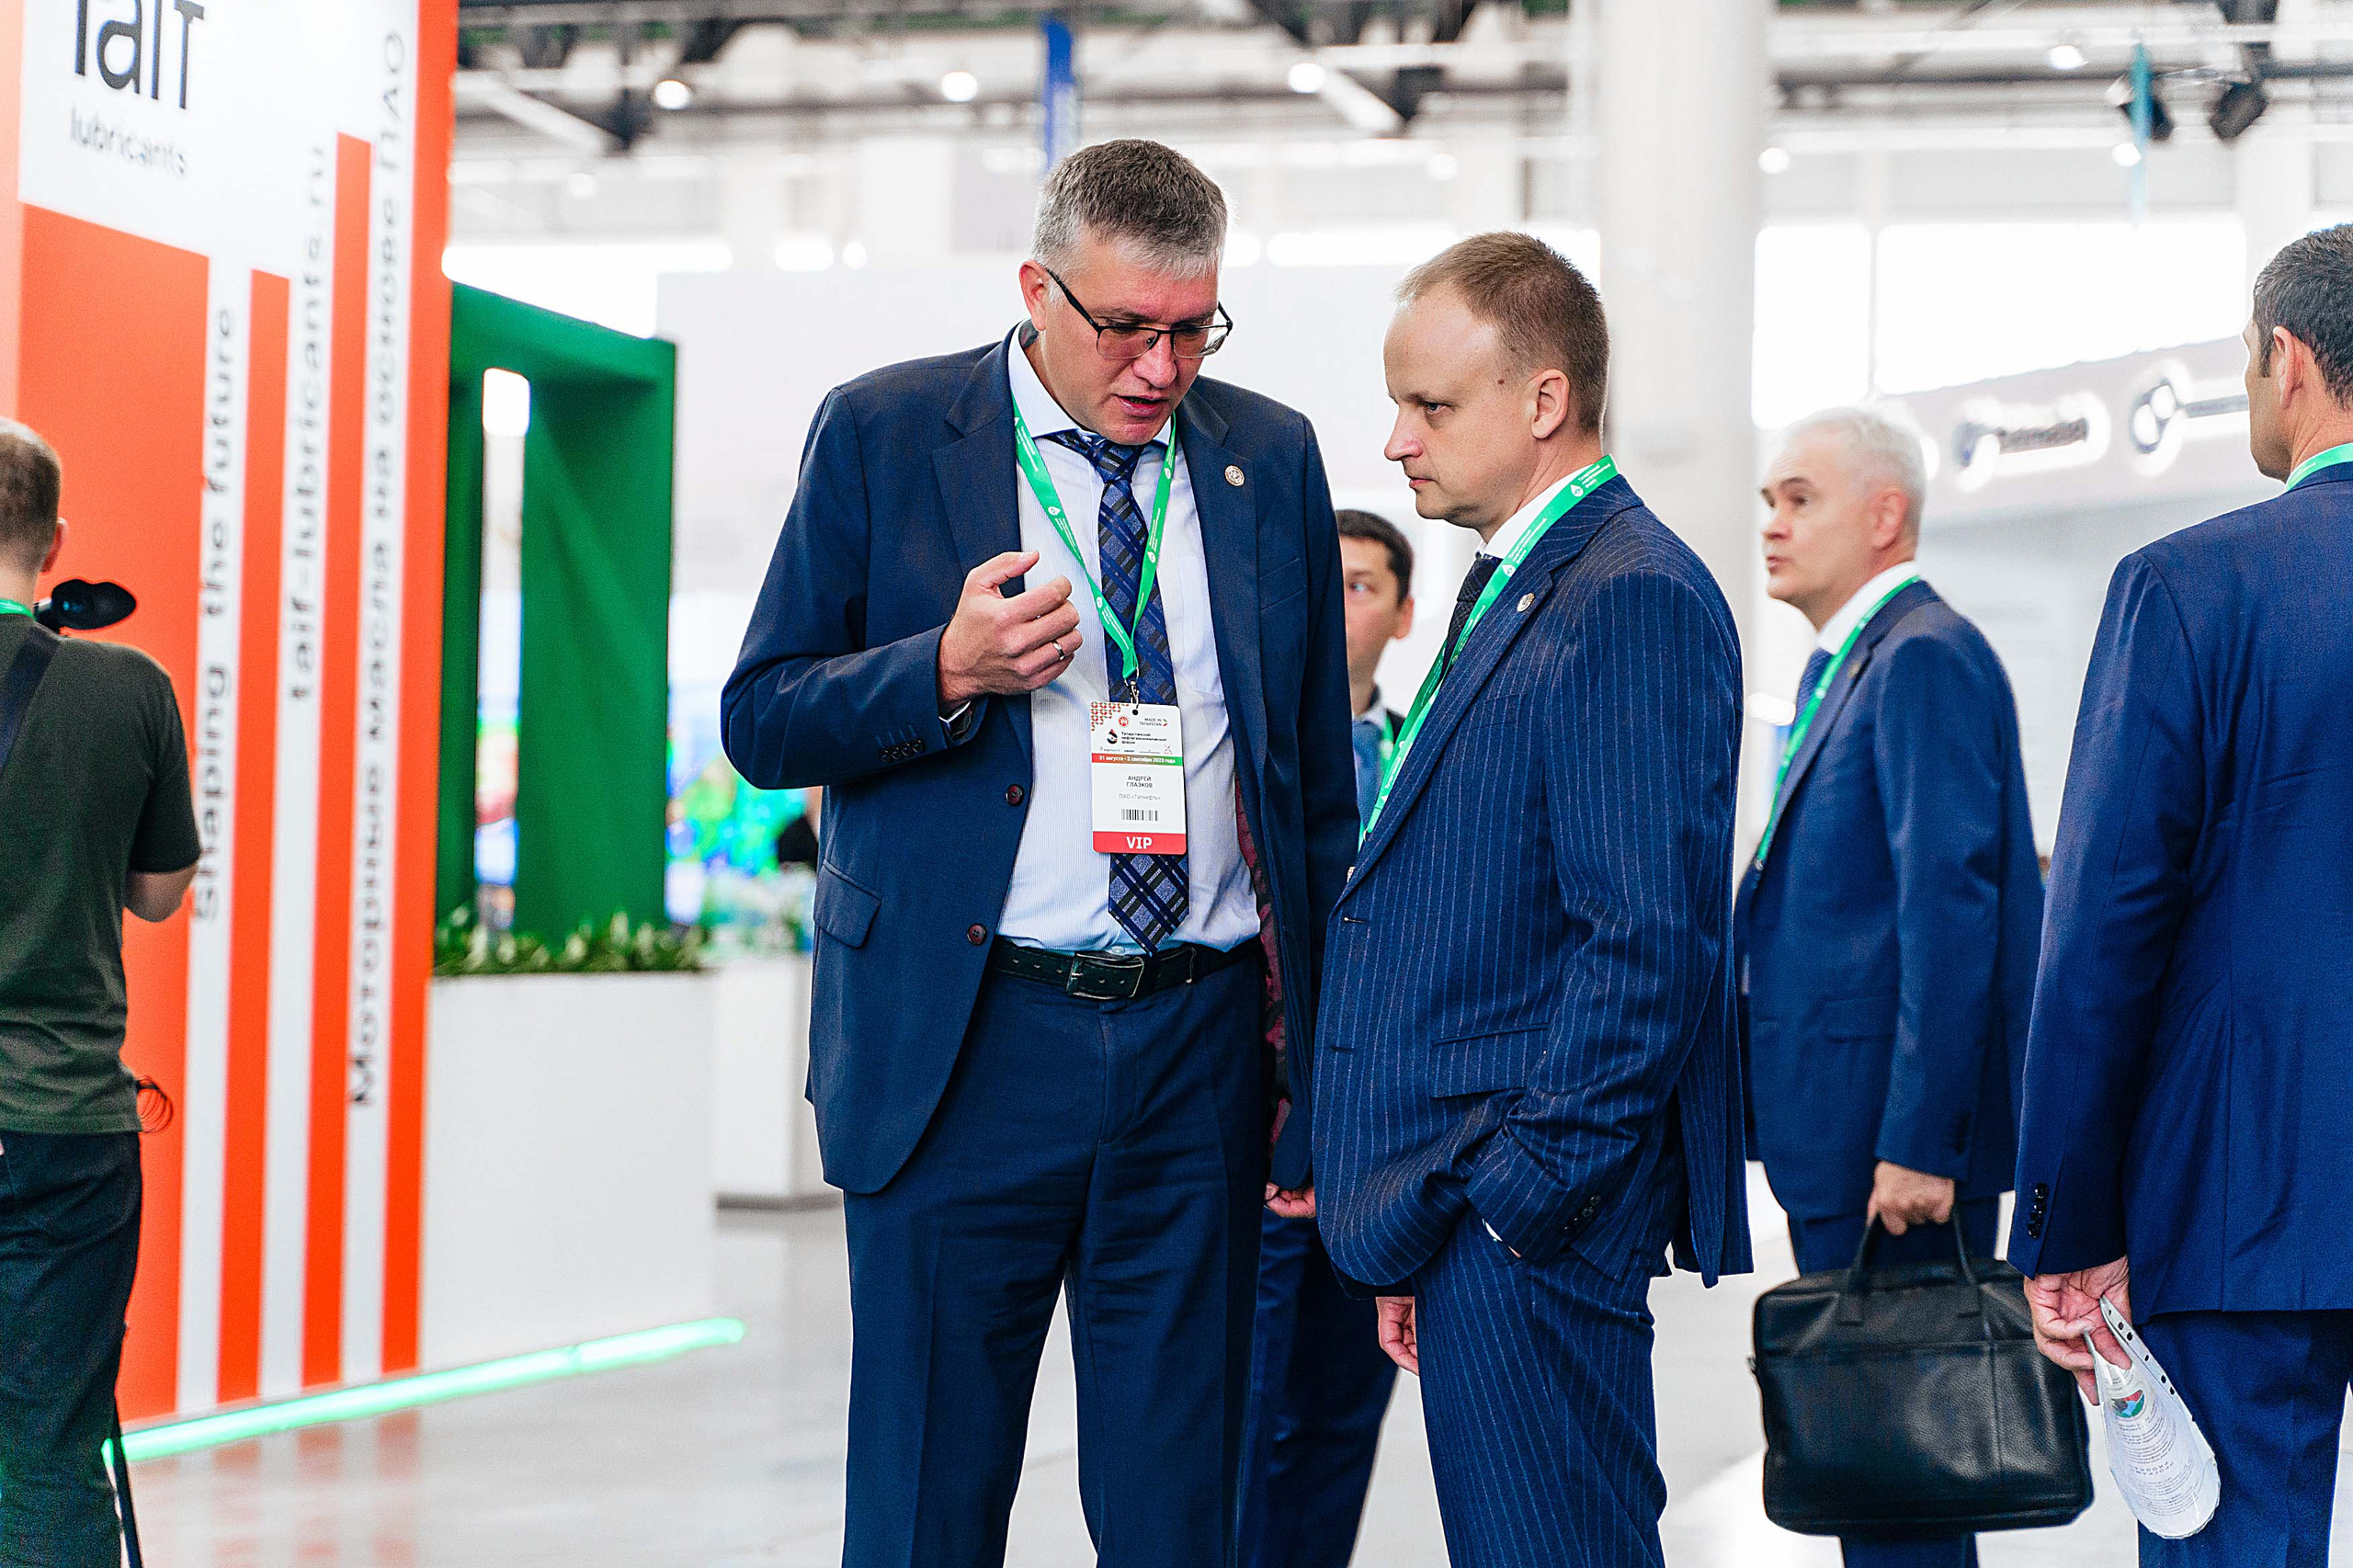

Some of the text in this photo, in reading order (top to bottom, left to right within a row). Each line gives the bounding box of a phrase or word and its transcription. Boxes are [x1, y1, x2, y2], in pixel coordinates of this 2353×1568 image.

[71, 104, 187, 176] lubricants
[195, 309, 233, 923] Shaping the future
[290, 146, 325, 700] taif-lubricants.ru
[349, 31, 406, 1107] Моторные масла на основе ПАО
[1126, 836, 1153, 850] VIP
